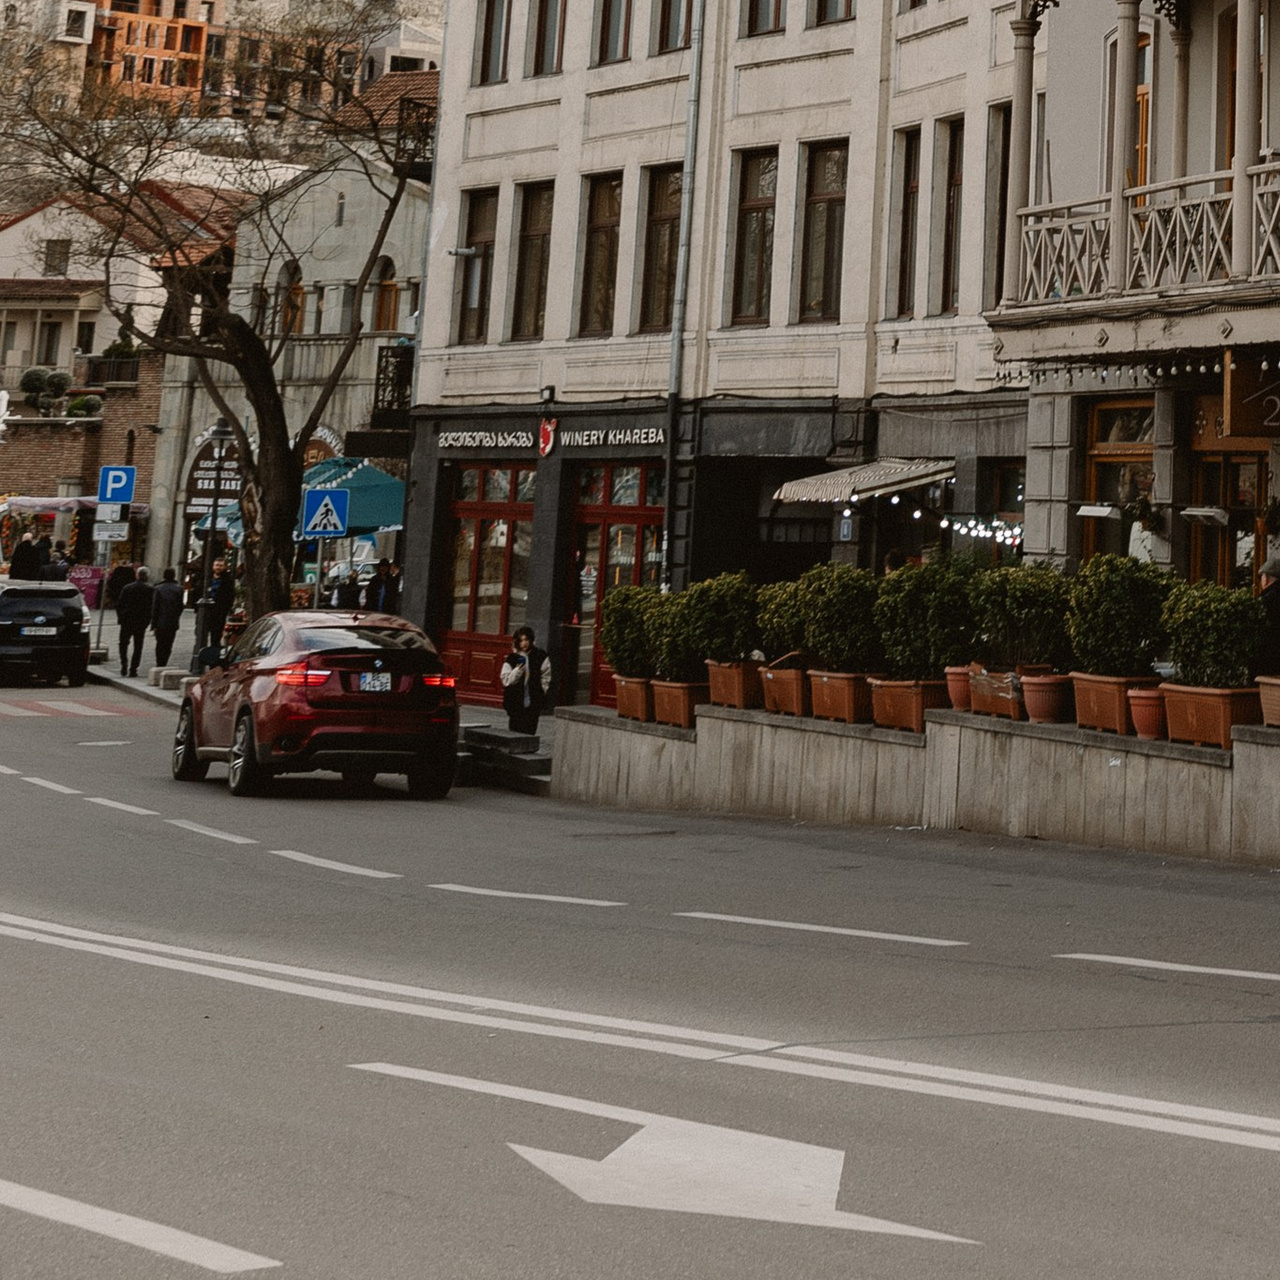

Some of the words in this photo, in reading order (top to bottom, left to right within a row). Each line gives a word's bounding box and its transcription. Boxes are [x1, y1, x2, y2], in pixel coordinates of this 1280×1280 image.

[560, 430, 605, 446] WINERY
[608, 428, 665, 445] KHAREBA
[106, 471, 127, 498] P
